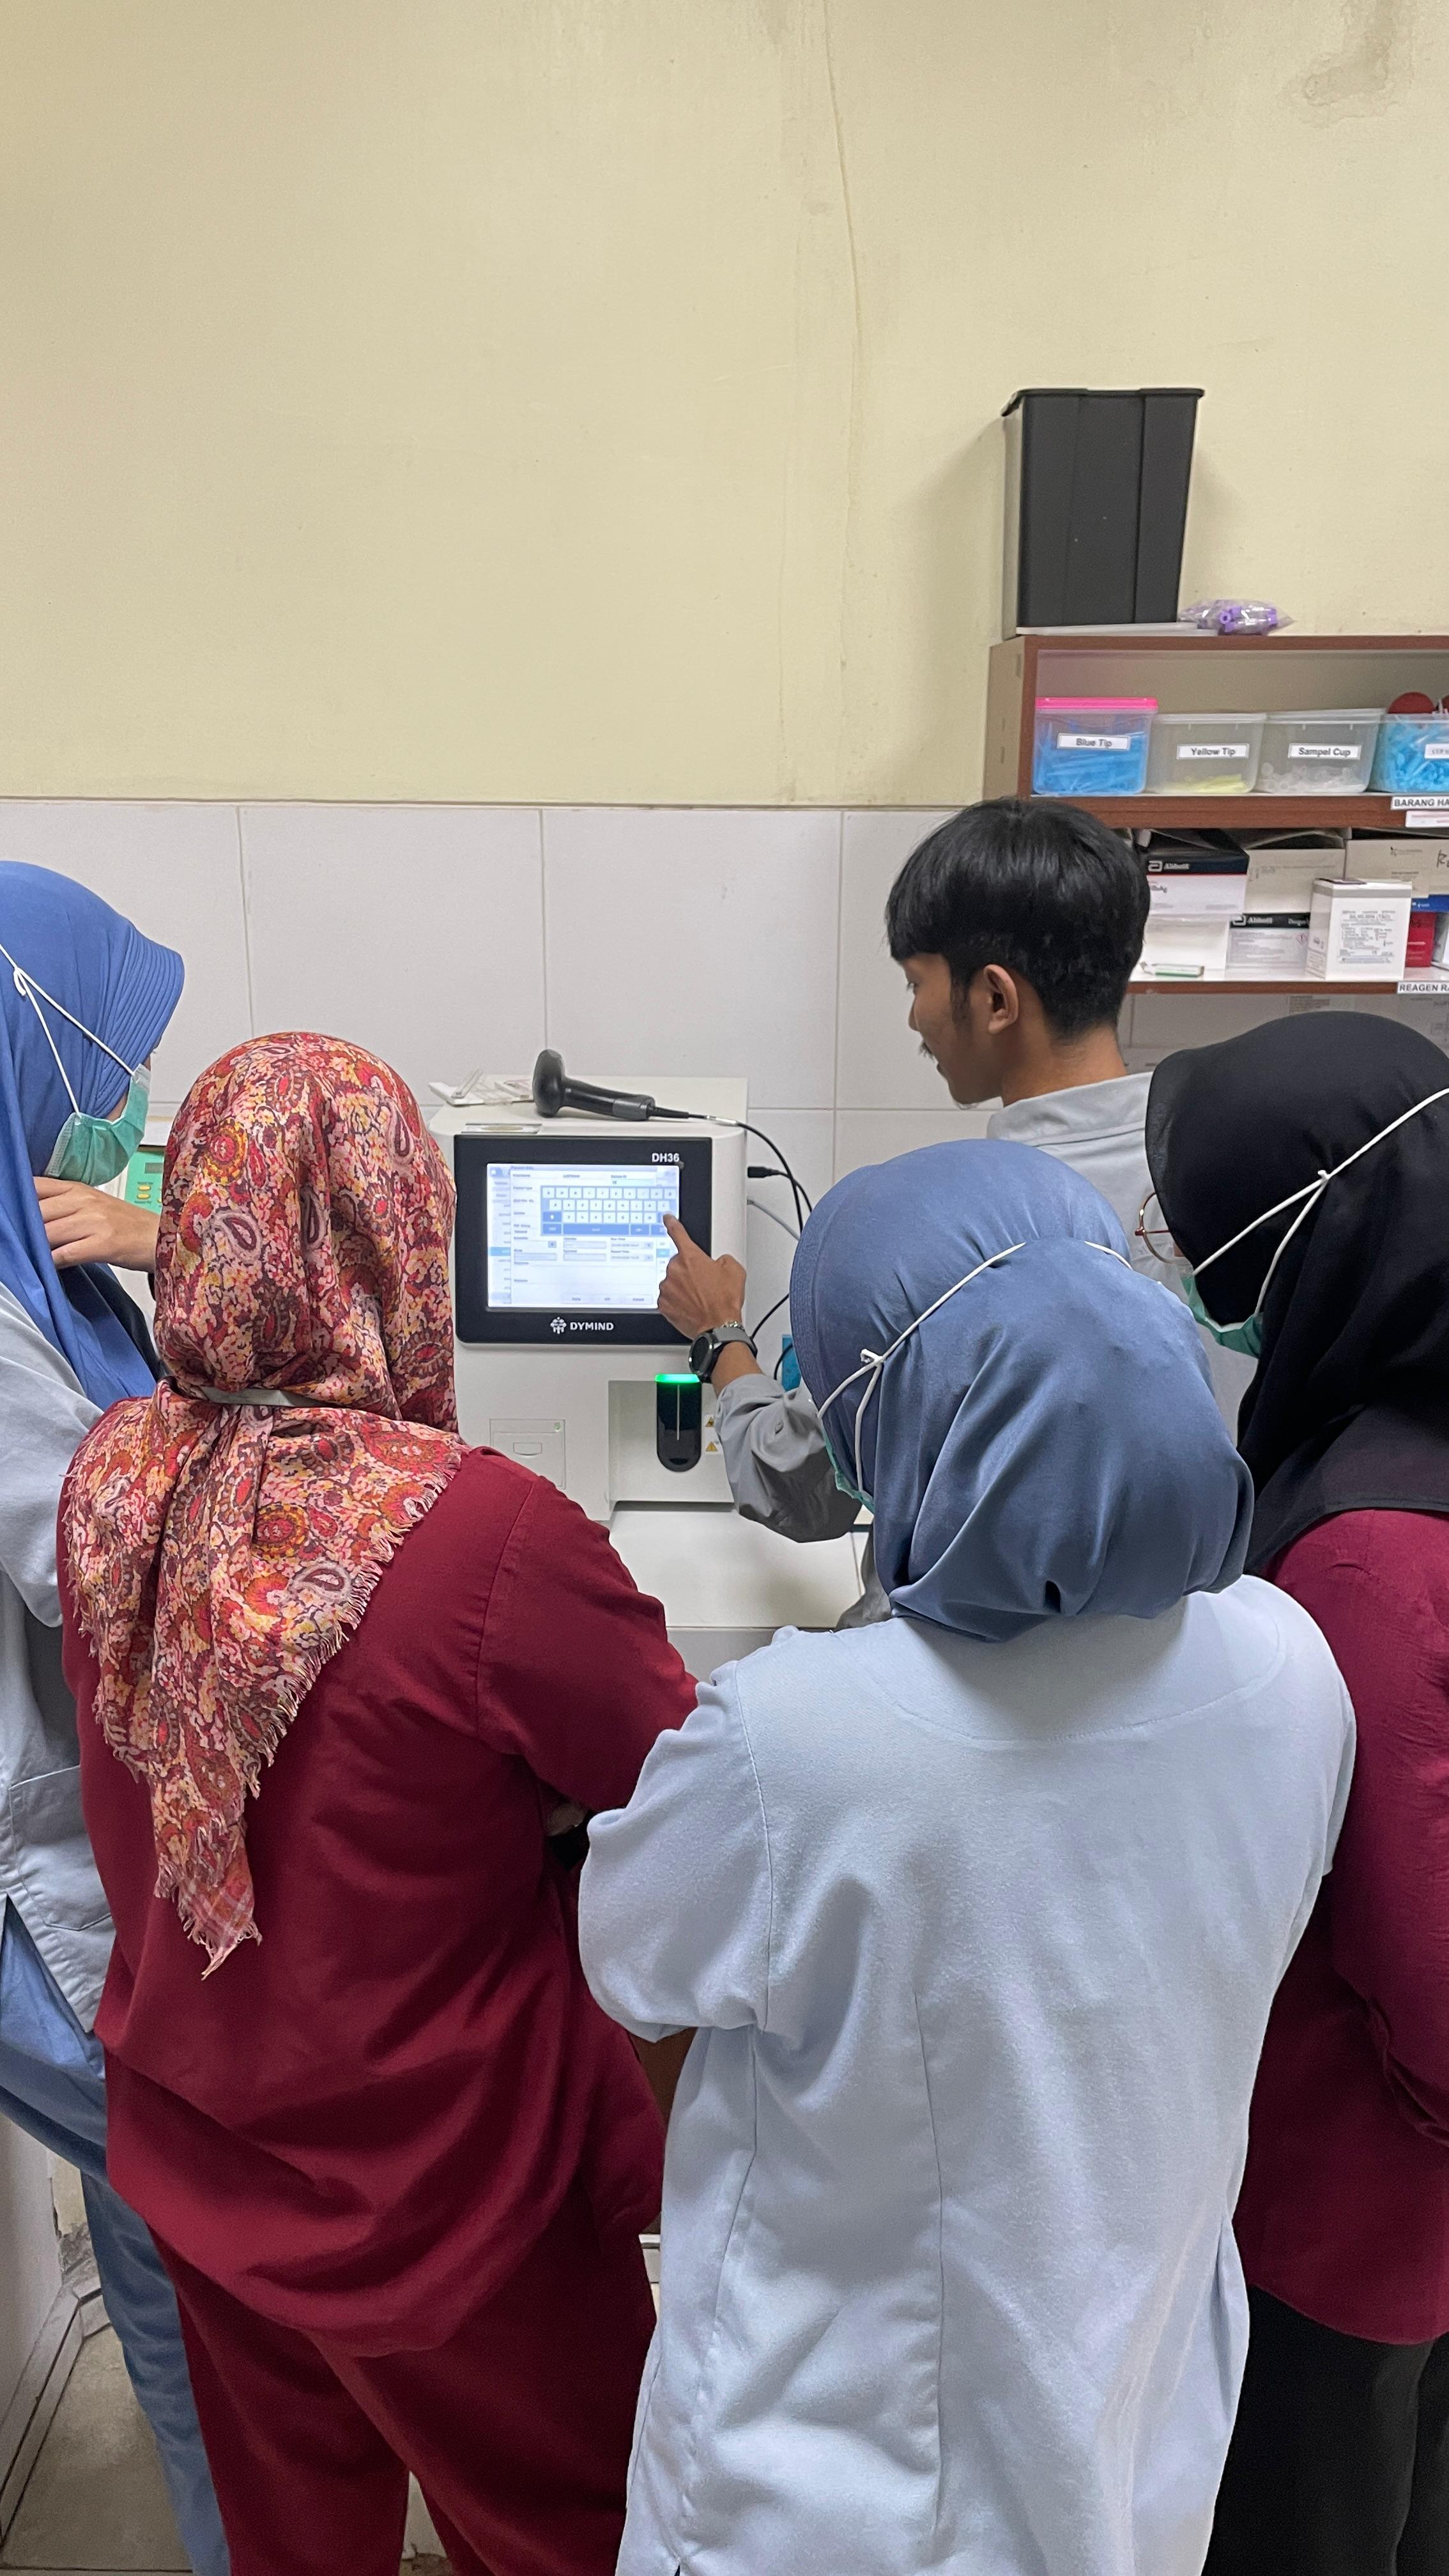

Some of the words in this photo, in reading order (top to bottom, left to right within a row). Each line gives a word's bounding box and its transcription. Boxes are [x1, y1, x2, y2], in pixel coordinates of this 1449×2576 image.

[1076, 738, 1096, 746] Blue
[1098, 739, 1112, 749] Tip
[1222, 747, 1236, 757] Tip
[1298, 747, 1331, 758] Sampel
[1333, 747, 1351, 758] Cup
[1394, 798, 1435, 806] BARANG
[652, 1153, 679, 1162] DH36
[570, 1322, 614, 1331] DYMIND
